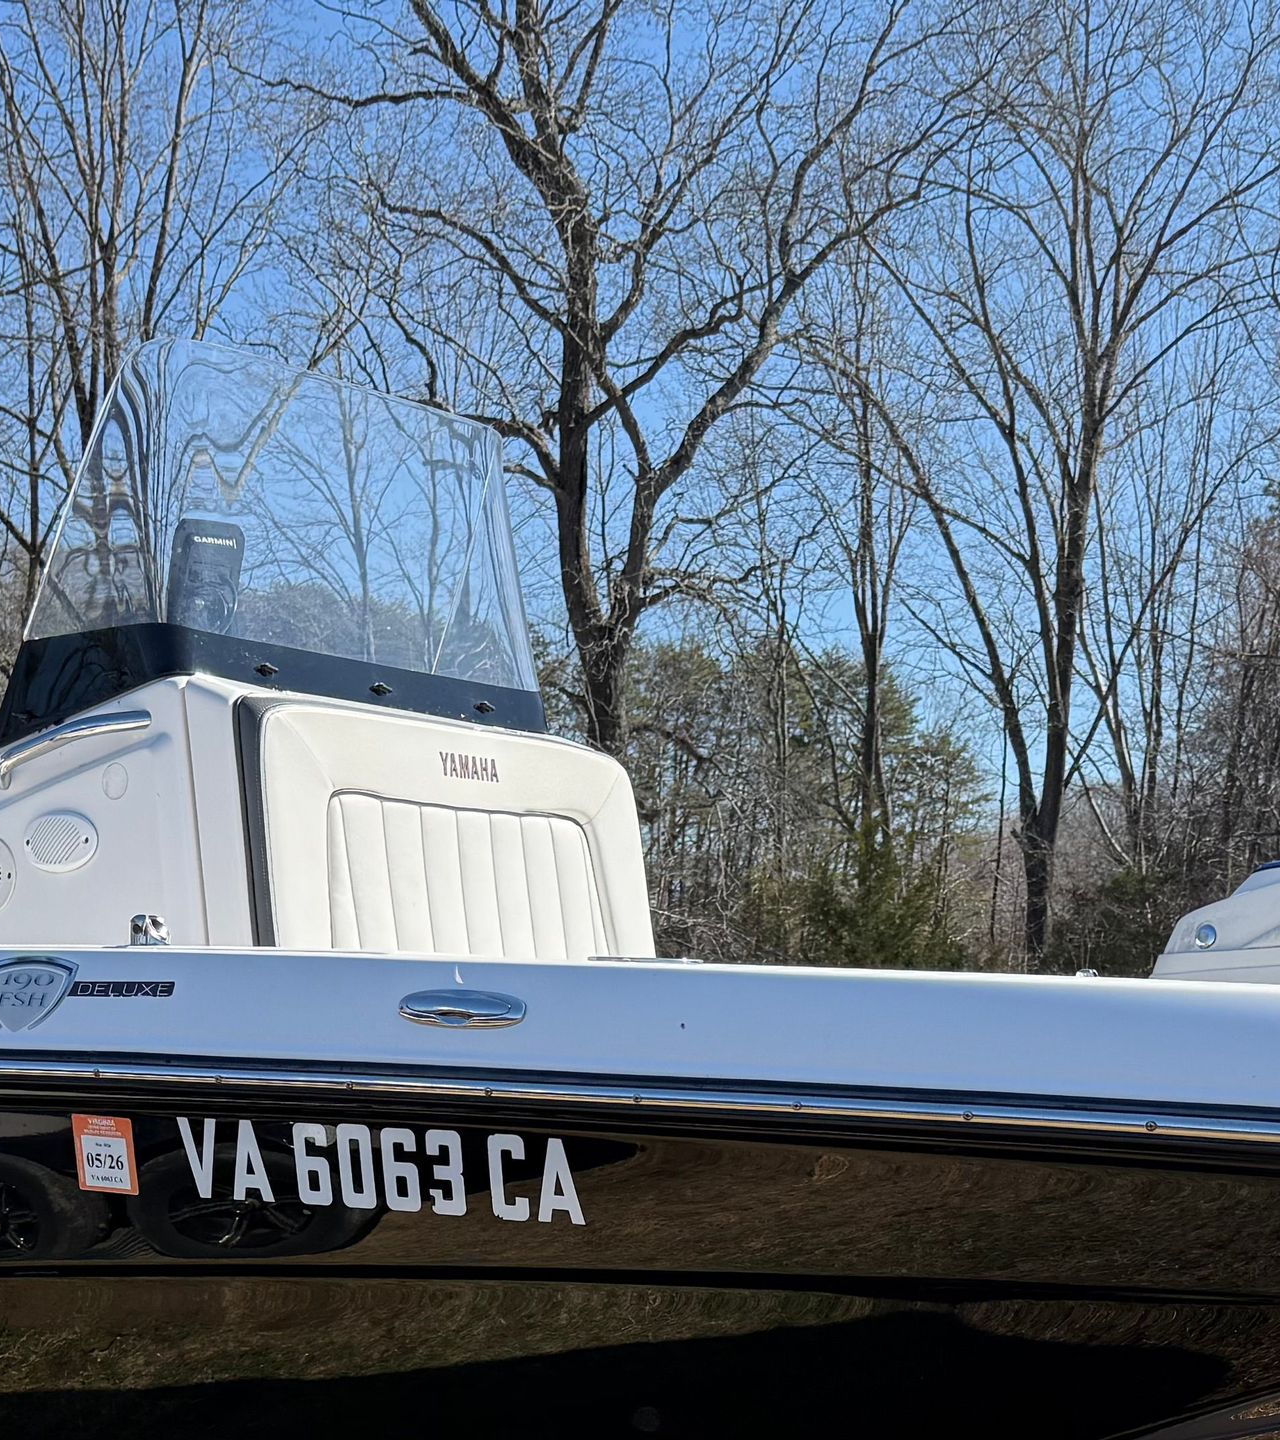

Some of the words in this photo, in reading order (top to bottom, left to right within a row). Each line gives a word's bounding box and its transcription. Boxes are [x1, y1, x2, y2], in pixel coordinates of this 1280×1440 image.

[193, 535, 233, 547] GARMIN
[438, 751, 500, 783] YAMAHA
[1, 972, 55, 990] 190
[76, 982, 172, 997] DELUXE
[86, 1152, 124, 1171] 05/26
[176, 1116, 275, 1203] VA
[292, 1122, 468, 1216] 6063
[489, 1133, 586, 1226] CA
